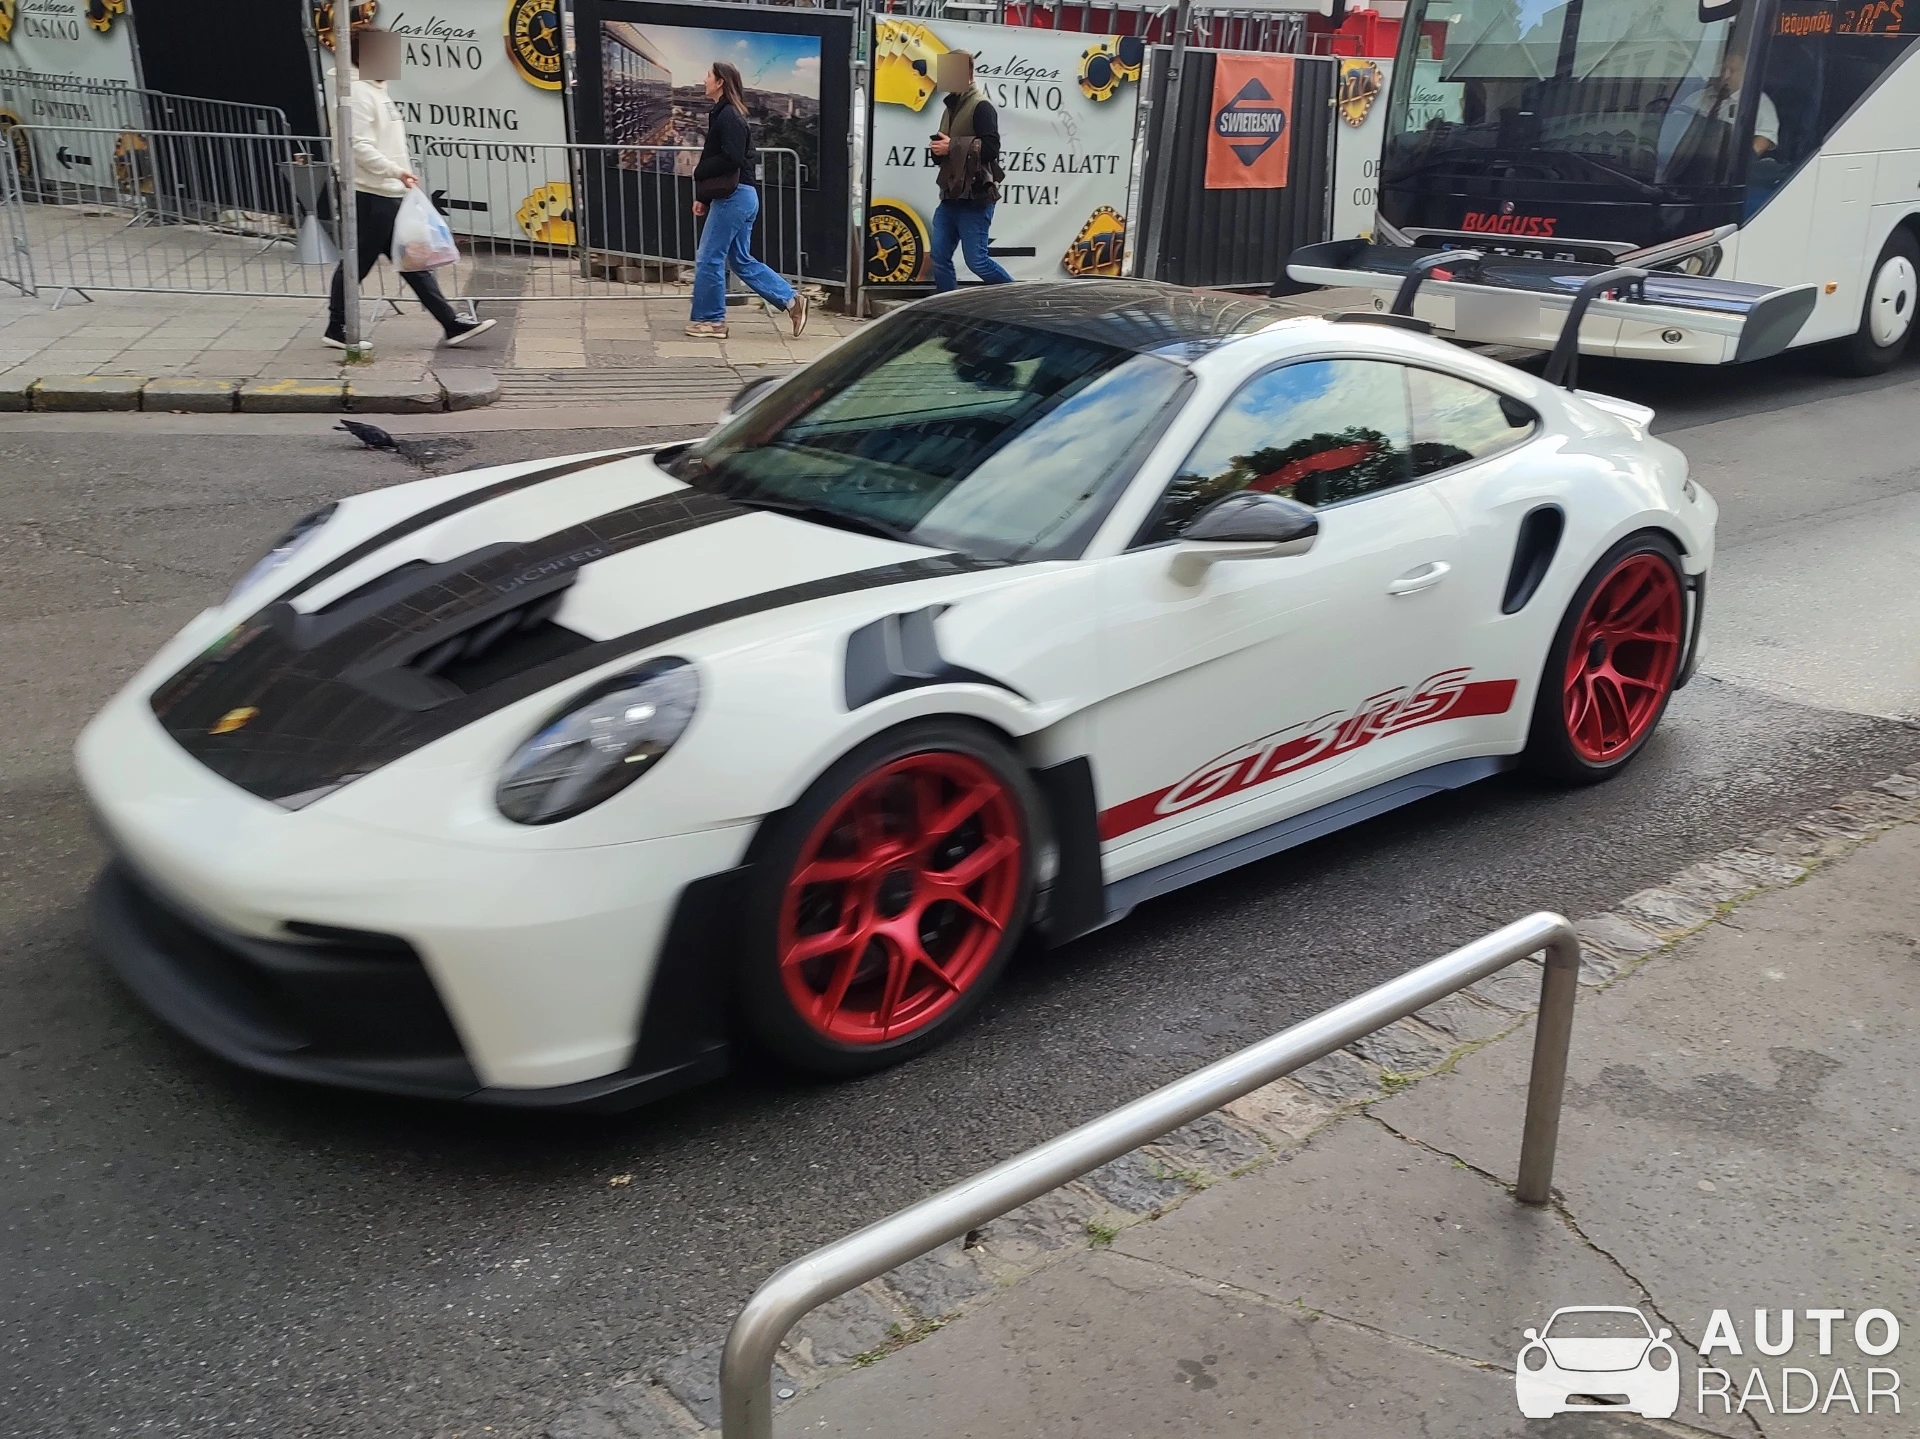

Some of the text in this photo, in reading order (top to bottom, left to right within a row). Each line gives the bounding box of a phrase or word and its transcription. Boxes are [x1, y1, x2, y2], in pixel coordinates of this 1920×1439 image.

[23, 17, 80, 41] CASINO
[425, 16, 476, 43] Vegas
[405, 42, 482, 70] ASINO
[1004, 55, 1061, 83] Vegas
[393, 101, 519, 131] EN DURING
[1220, 112, 1281, 133] SWIETELSKY
[885, 146, 916, 167] AZ
[1051, 153, 1119, 174] ALATT
[1461, 212, 1557, 237] BLAGUSS
